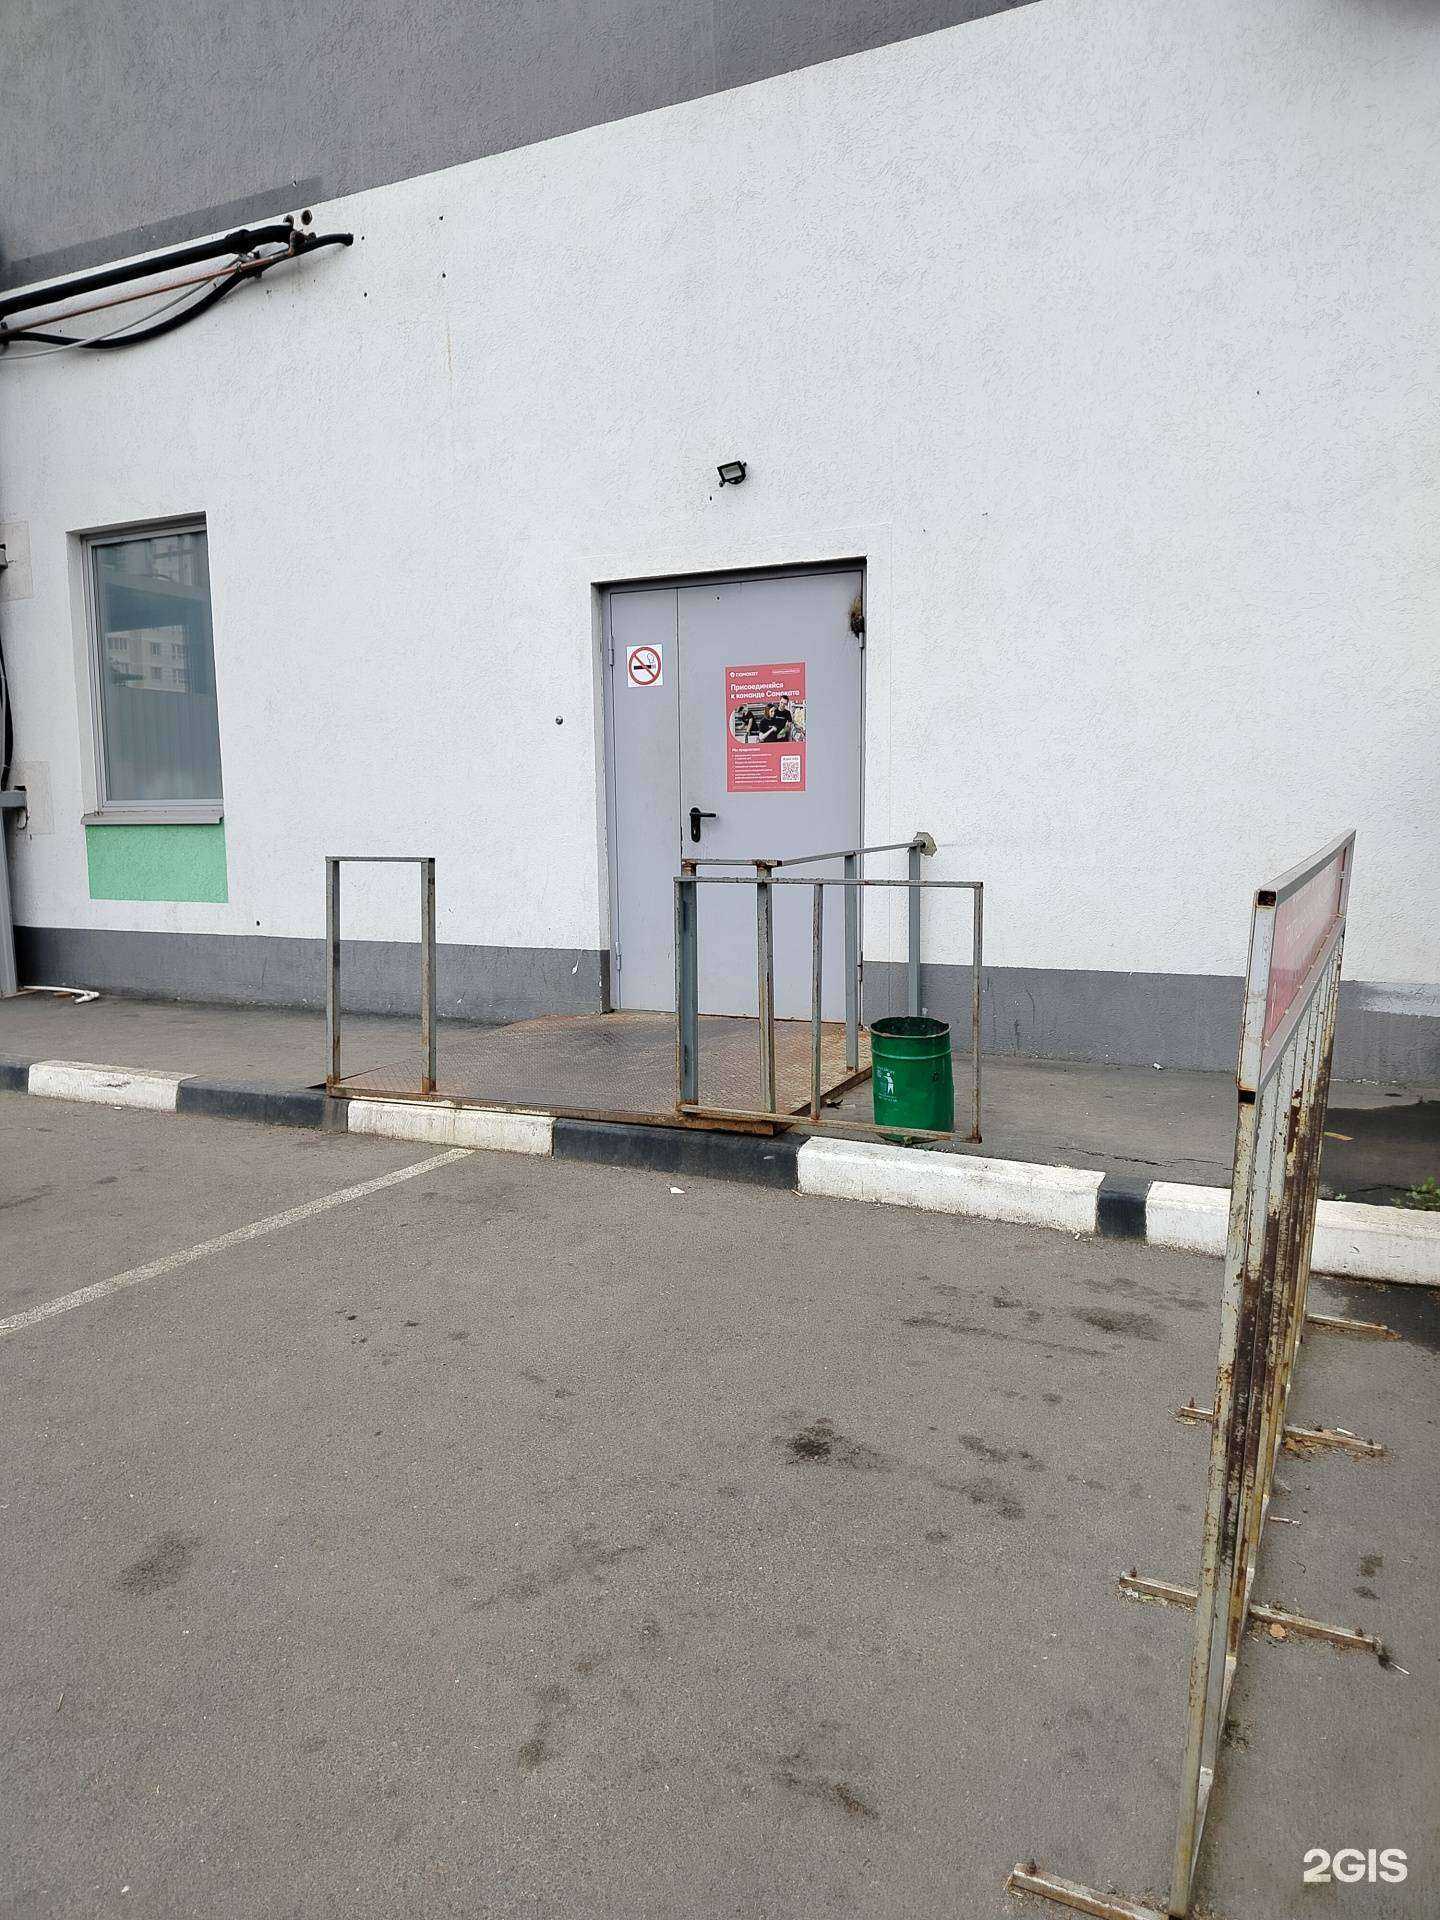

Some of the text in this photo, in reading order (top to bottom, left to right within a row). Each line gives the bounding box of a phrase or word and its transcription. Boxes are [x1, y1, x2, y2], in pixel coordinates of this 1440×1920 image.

[730, 682, 784, 692] Присоединяйся
[736, 691, 765, 700] команде
[766, 690, 800, 698] Самоката
